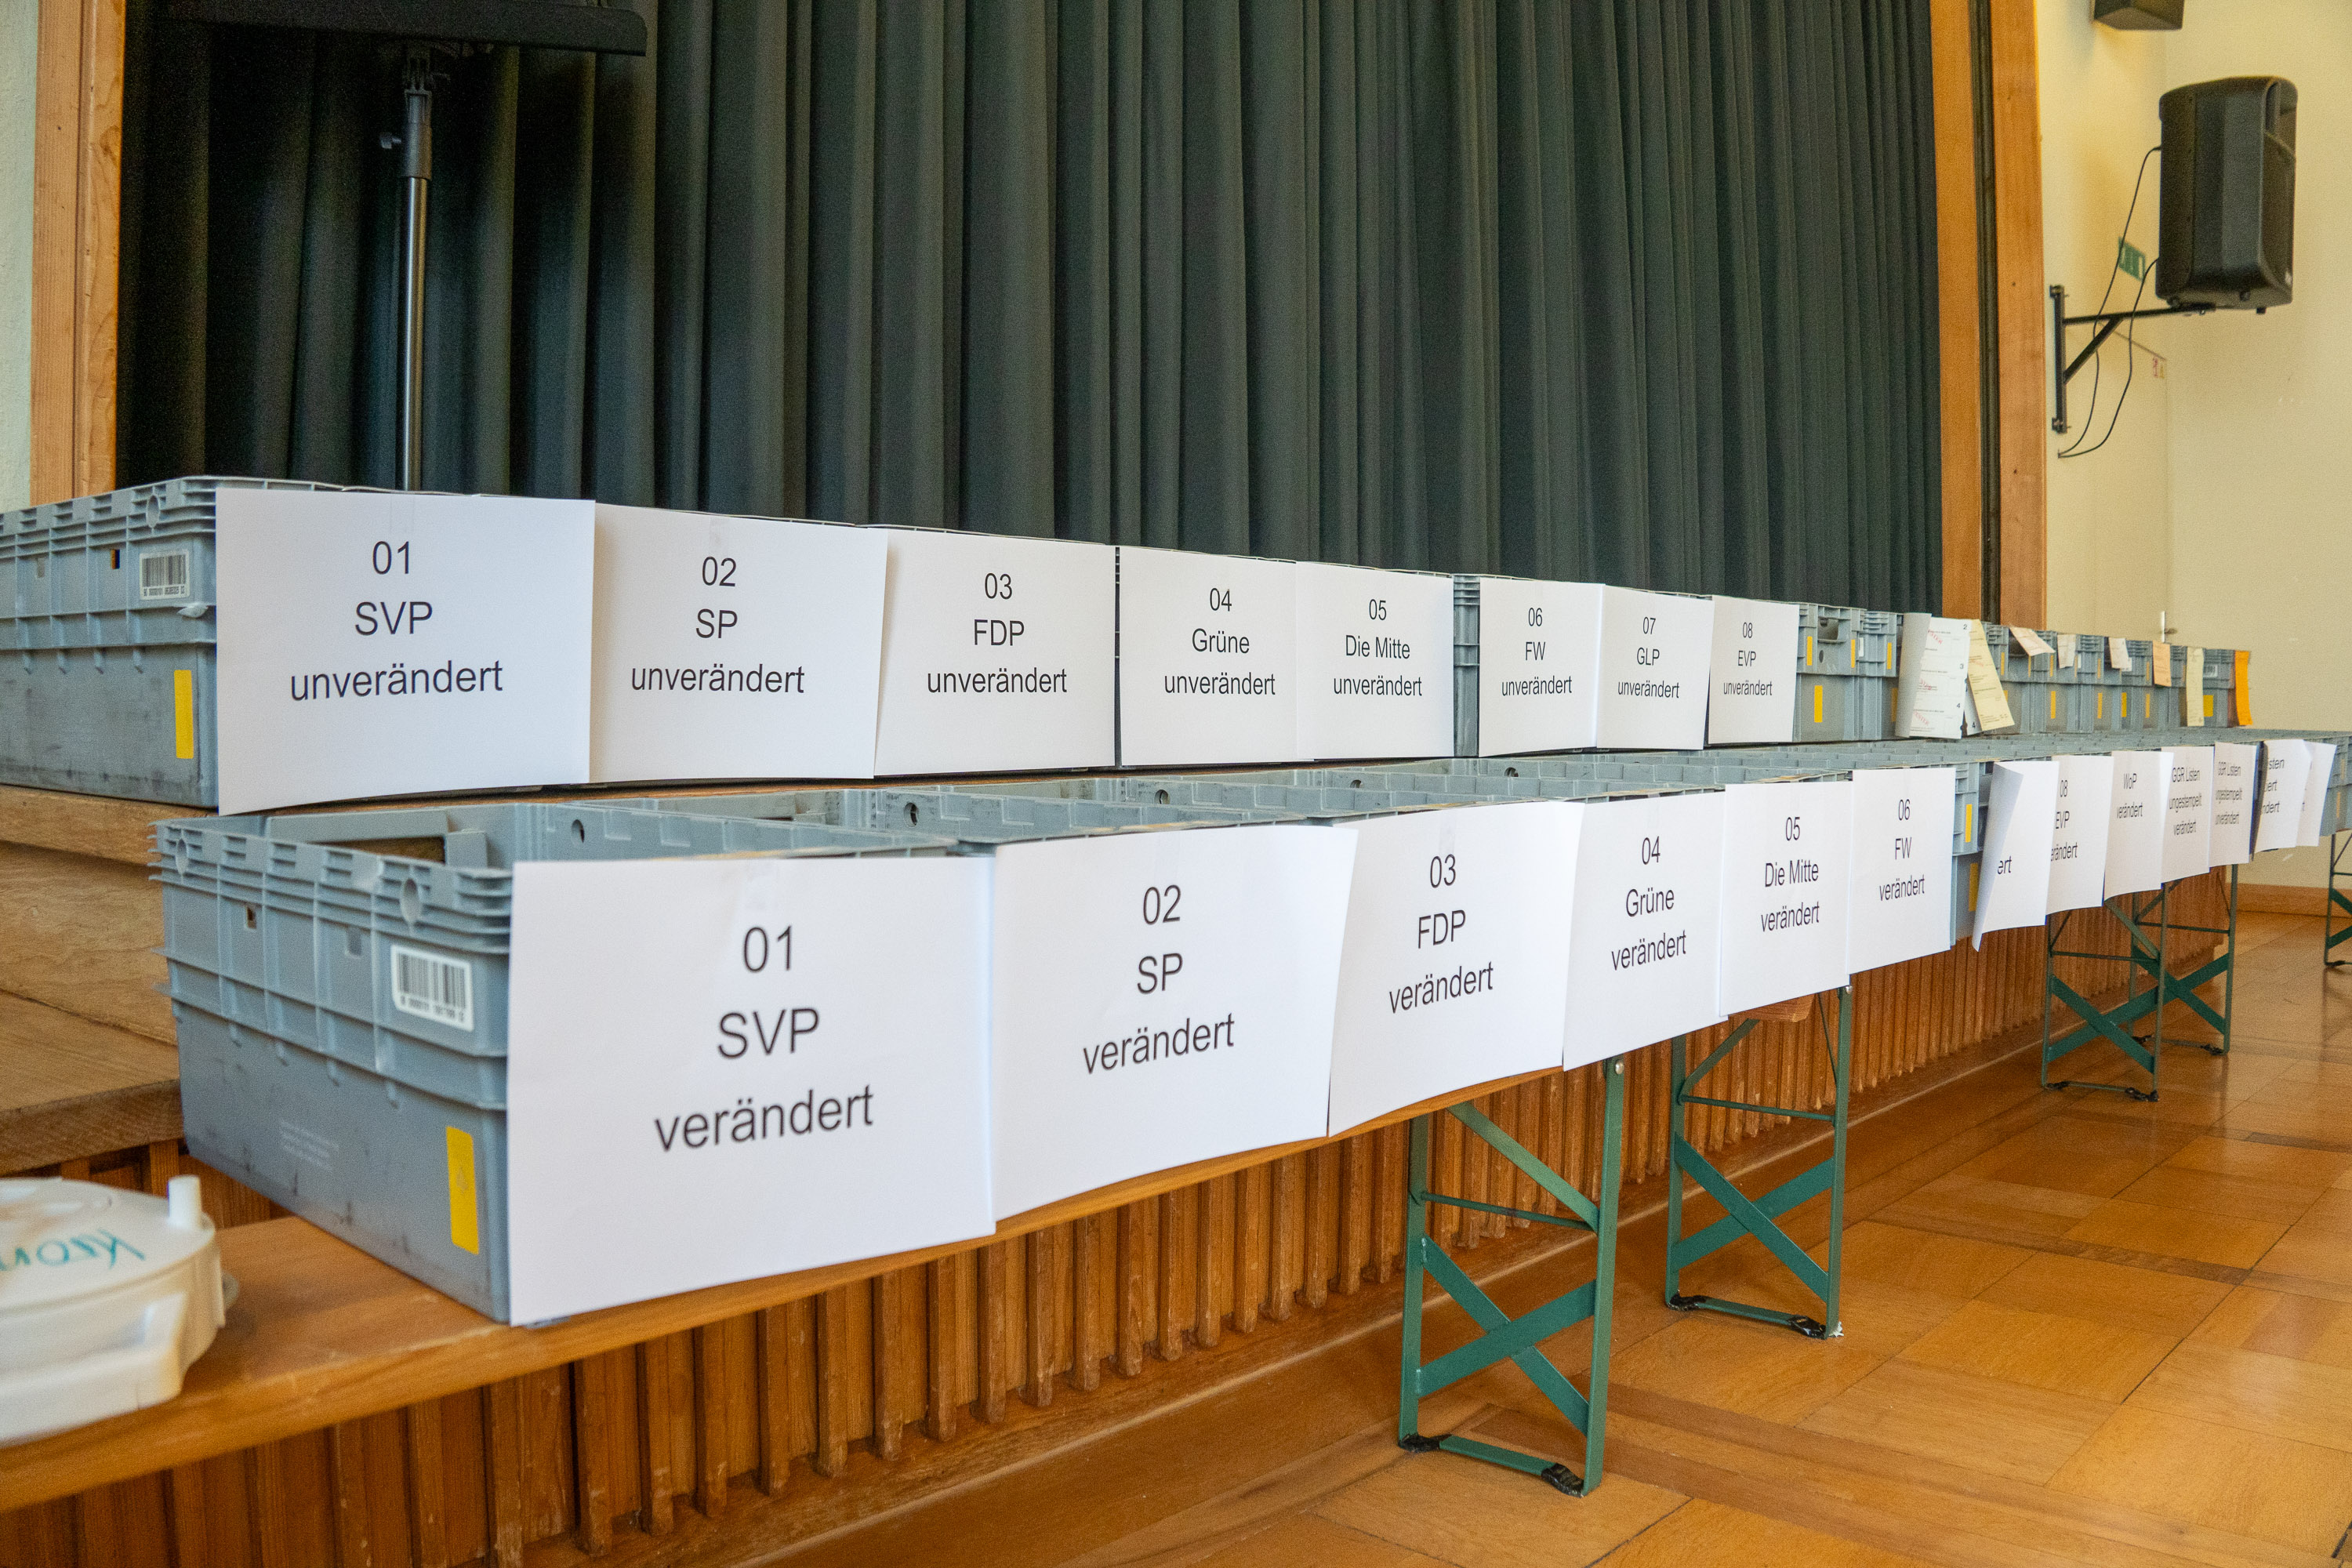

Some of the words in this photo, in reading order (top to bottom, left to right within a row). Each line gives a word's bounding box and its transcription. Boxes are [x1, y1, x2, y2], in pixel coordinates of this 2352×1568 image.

[373, 541, 408, 575] 01
[702, 557, 736, 586] 02
[985, 573, 1012, 599] 03
[1210, 588, 1232, 612] 04
[1370, 599, 1386, 620] 05
[355, 601, 432, 636] SVP
[696, 608, 738, 638] SP
[1529, 608, 1542, 626] 06
[1643, 617, 1656, 634] 07
[975, 619, 1024, 646] FDP
[1192, 628, 1249, 653] Grüne
[1743, 622, 1752, 638] 08
[1346, 635, 1370, 657] Die
[1376, 637, 1410, 659] Mitte
[1526, 642, 1545, 660] FW
[1637, 648, 1660, 665] GLP
[1738, 651, 1756, 666] EVP
[292, 660, 503, 701] unverändert
[632, 663, 804, 693] unverändert
[928, 667, 1067, 692] unverändert
[1165, 672, 1275, 695] unverändert
[1334, 675, 1422, 696] unverändert
[1502, 676, 1572, 696] unverändert
[1618, 681, 1679, 698] unverändert
[1724, 681, 1772, 695] unverändert
[2123, 773, 2137, 789] WoP
[2186, 768, 2200, 782] Listen
[2060, 779, 2067, 797] 08
[1899, 799, 1910, 821] 06
[2116, 801, 2143, 818] verändert
[2169, 792, 2201, 813] ungestempelt
[1786, 817, 1800, 841] 05
[2056, 811, 2069, 829] EVP
[2173, 818, 2197, 836] verändert
[1642, 836, 1661, 865] 04
[1896, 837, 1911, 859] FW
[1430, 854, 1456, 888] 03
[1766, 862, 1784, 887] Die
[1790, 859, 1818, 884] Mitte
[1880, 875, 1925, 901] verändert
[1143, 885, 1181, 925] 02
[1626, 887, 1674, 916] Grüne
[1761, 902, 1819, 931] verändert
[1418, 910, 1465, 949] FDP
[743, 926, 791, 973] 01
[1612, 931, 1686, 970] verändert
[1138, 953, 1182, 994] SP
[1389, 962, 1493, 1014] verändert
[718, 1007, 819, 1059] SVP
[1083, 1013, 1234, 1074] verändert
[655, 1085, 873, 1152] verändert
